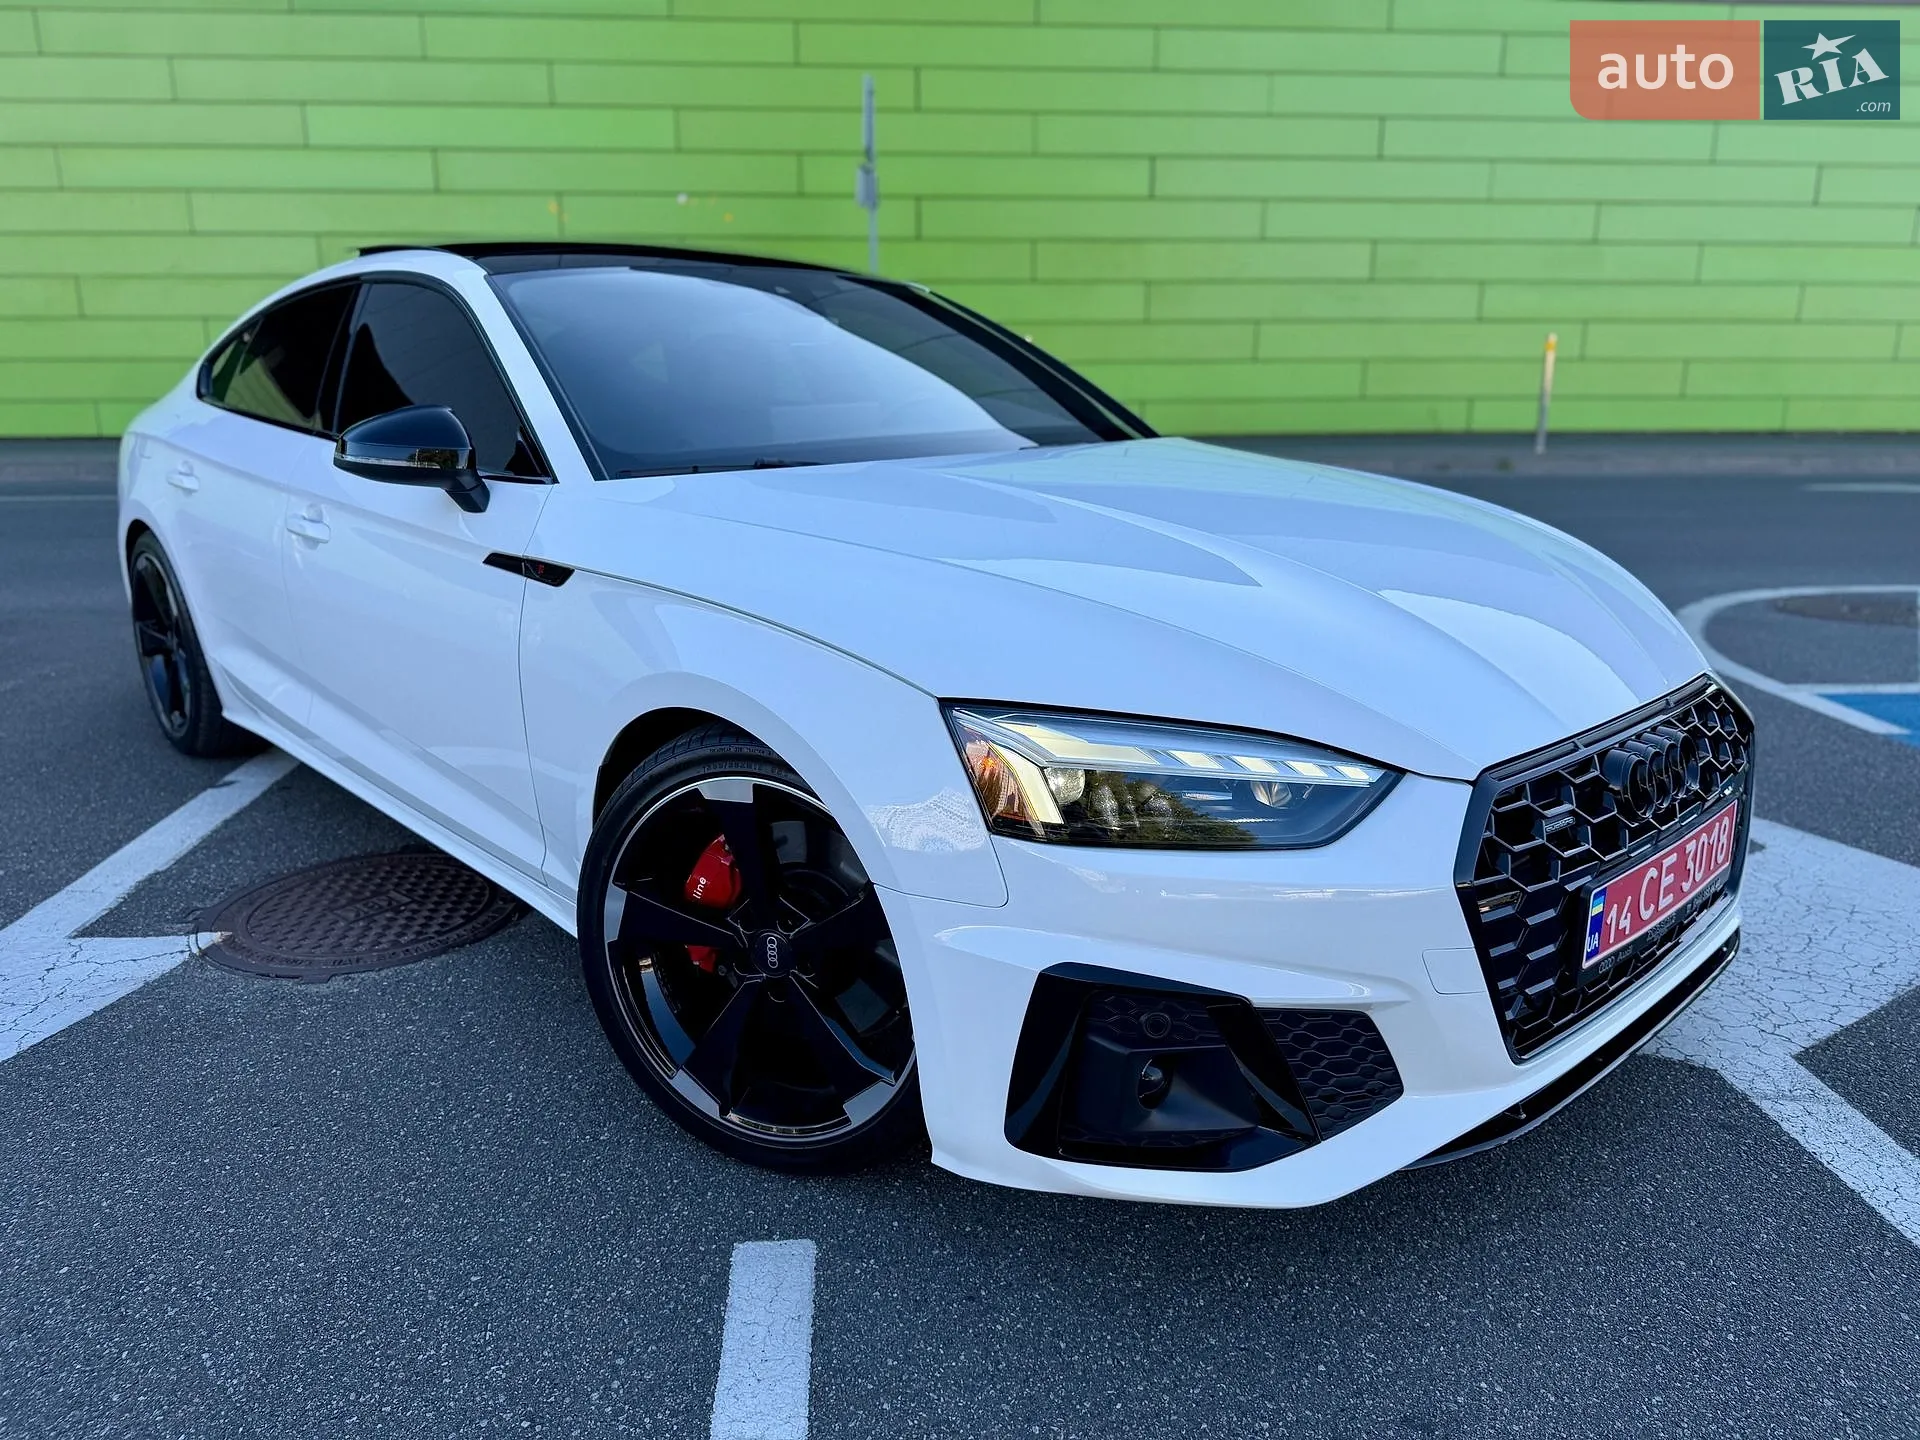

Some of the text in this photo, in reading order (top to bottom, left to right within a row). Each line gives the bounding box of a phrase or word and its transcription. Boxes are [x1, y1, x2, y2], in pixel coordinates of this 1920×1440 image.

[692, 877, 707, 899] line
[1606, 895, 1632, 944] 14
[1639, 852, 1678, 921] CE
[1682, 816, 1730, 892] 3018
[1587, 932, 1599, 951] UA
